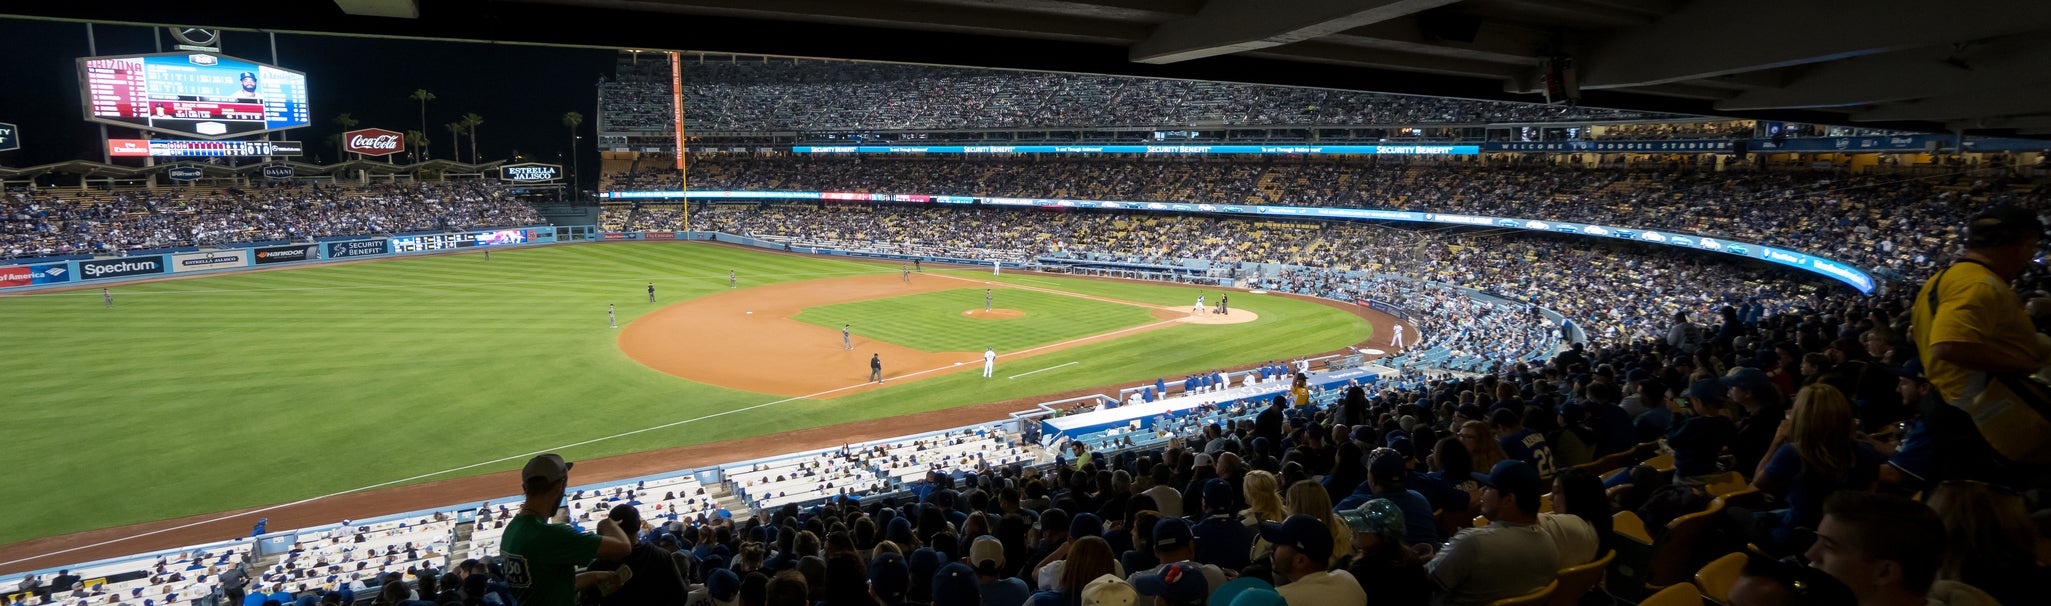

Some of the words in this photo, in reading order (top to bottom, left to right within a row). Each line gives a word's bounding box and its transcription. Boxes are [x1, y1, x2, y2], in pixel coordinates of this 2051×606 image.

[350, 134, 398, 150] Coca-Cola
[1376, 146, 1414, 154] SECURITY
[349, 240, 383, 249] SECURITY
[349, 247, 382, 256] BENEFIT
[85, 261, 155, 276] Spectrum
[8, 272, 45, 281] America
